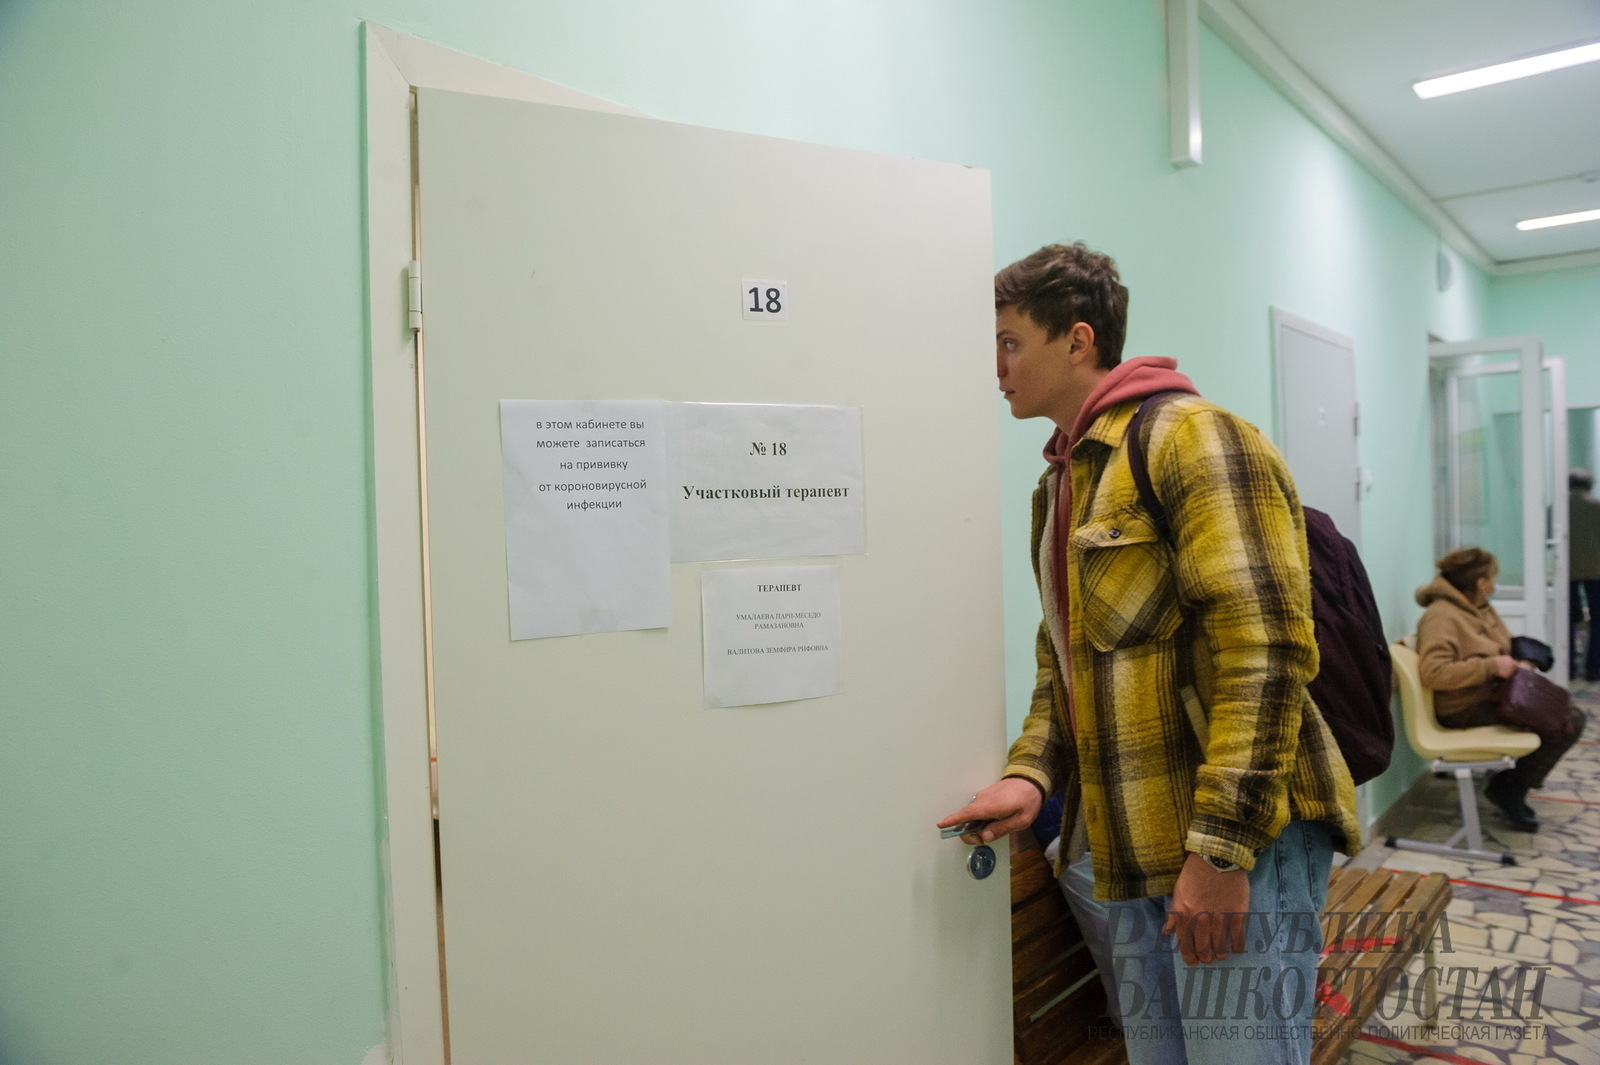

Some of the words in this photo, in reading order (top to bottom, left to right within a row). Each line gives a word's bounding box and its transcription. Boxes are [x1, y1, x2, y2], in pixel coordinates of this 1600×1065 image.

[748, 286, 782, 314] 18
[536, 421, 542, 429] в
[546, 421, 572, 429] этом
[576, 418, 627, 429] кабинете
[630, 420, 645, 429] вы
[536, 440, 580, 449] можете
[586, 438, 646, 448] записаться
[750, 441, 767, 456] №
[771, 442, 787, 456] 18
[560, 461, 573, 470] на
[576, 460, 628, 471] прививку
[538, 483, 551, 492] от
[554, 479, 647, 493] короновирусной
[682, 485, 781, 500] Участковый
[785, 487, 850, 501] терапевт
[566, 499, 622, 511] инфекции
[757, 584, 803, 592] ТЕРАПЕВТ
[754, 622, 804, 630] РАМАЗАНОВНА
[766, 646, 797, 654] ЗЕМФИРА
